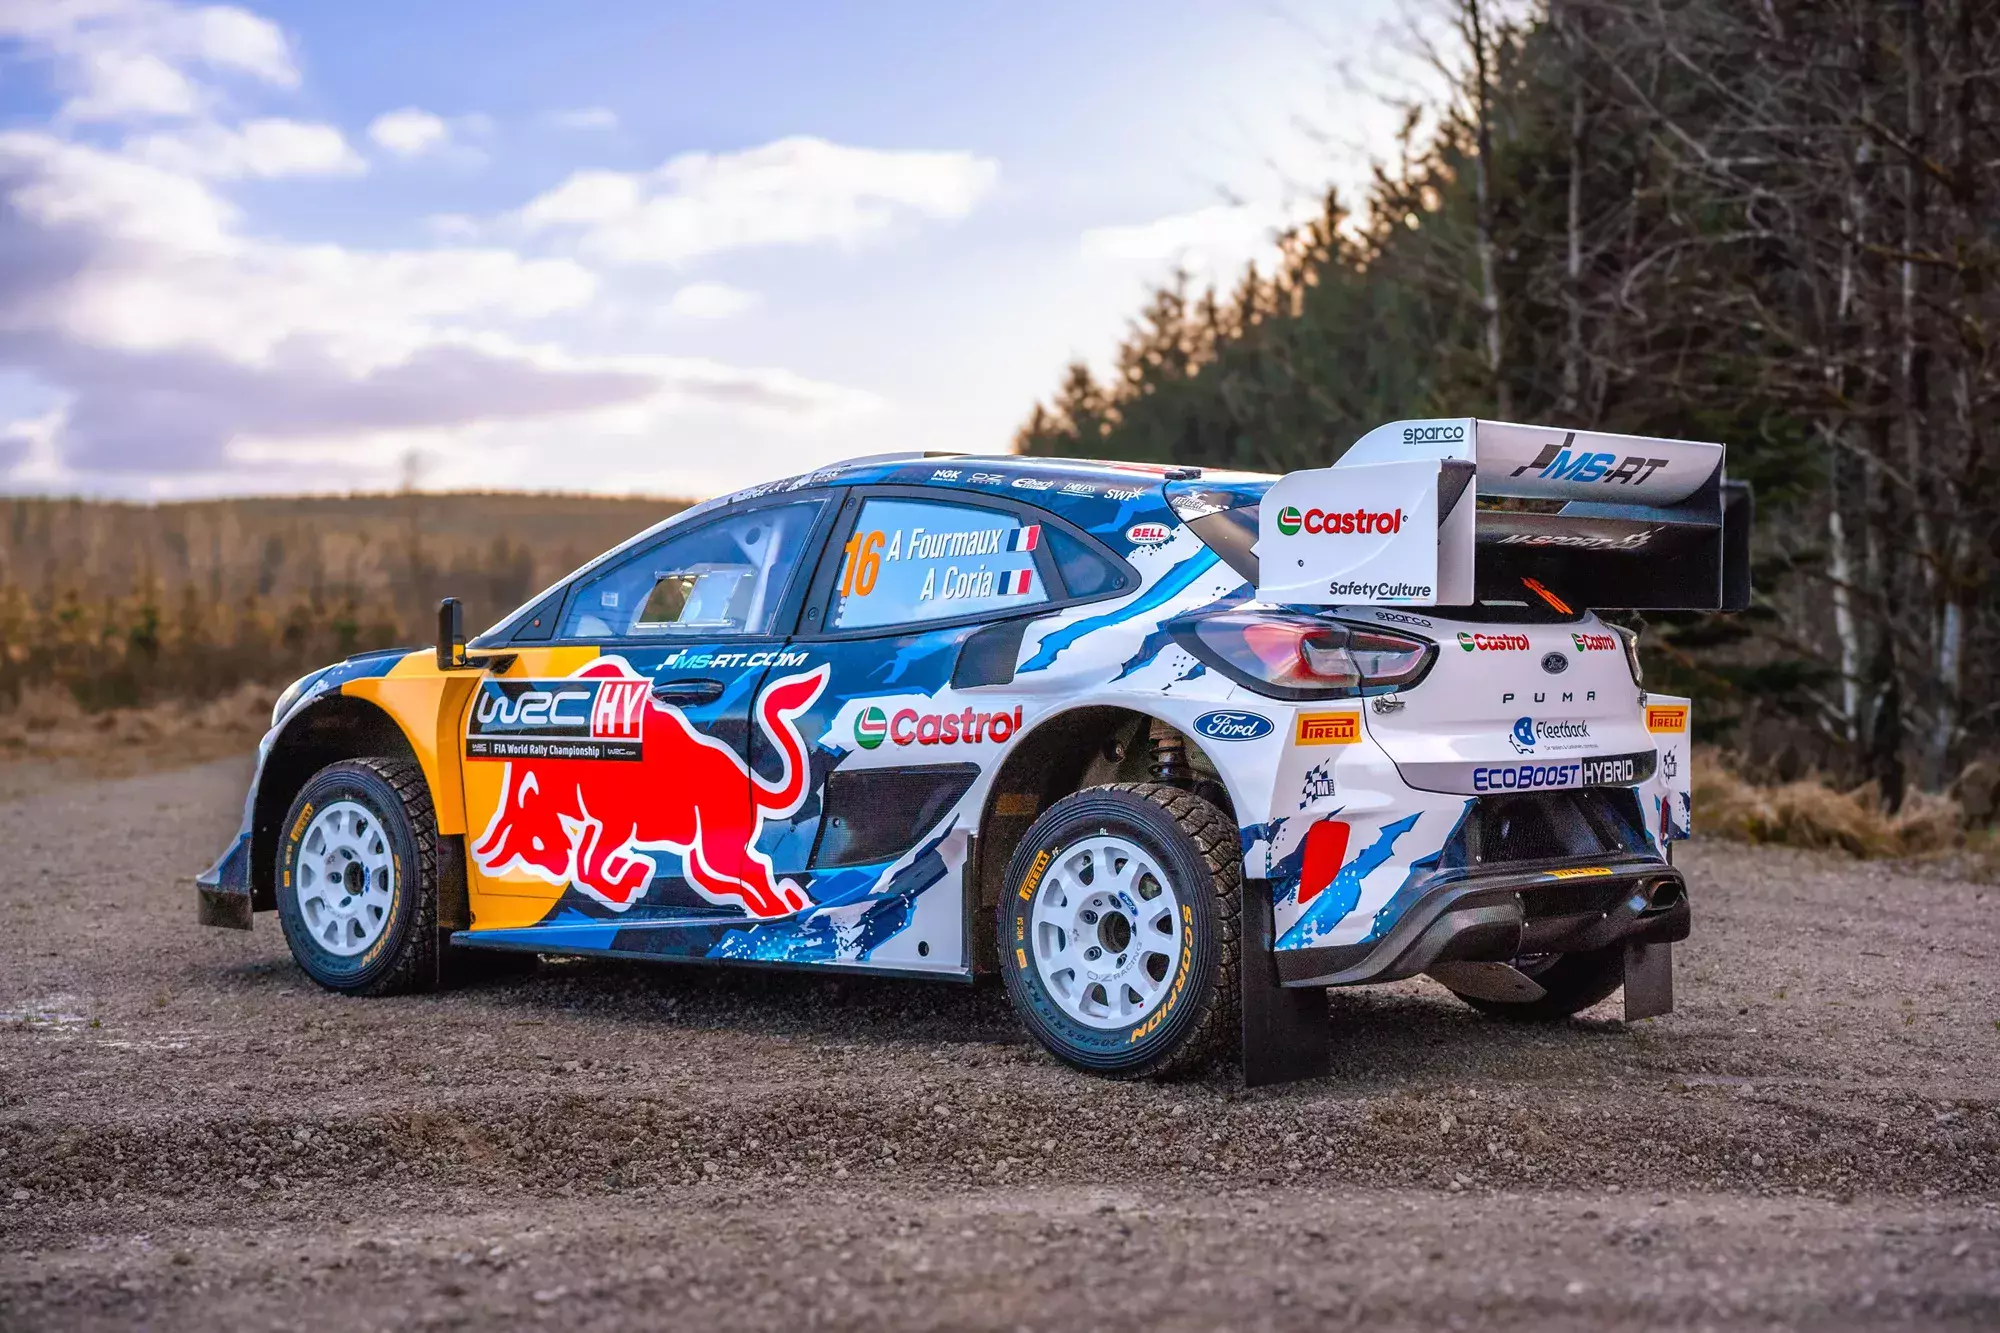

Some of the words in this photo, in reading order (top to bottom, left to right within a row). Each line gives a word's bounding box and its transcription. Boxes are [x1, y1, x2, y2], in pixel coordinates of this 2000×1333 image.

[1402, 426, 1464, 445] sparco
[933, 469, 962, 479] NGK
[1538, 449, 1669, 485] MS-RT
[1104, 488, 1136, 501] SWP
[1304, 508, 1401, 535] Castrol
[1132, 528, 1164, 538] BELL
[886, 529, 902, 562] A
[907, 527, 1003, 561] Fourmaux
[844, 530, 885, 597] 16
[920, 568, 936, 600] A
[943, 564, 994, 600] Coria
[1329, 581, 1432, 600] SafetyCulture
[1375, 611, 1433, 628] sparco
[1474, 633, 1530, 651] Castrol
[1582, 634, 1617, 651] Castrol
[1502, 691, 1596, 704] PUMA
[477, 691, 591, 725] WRC
[596, 684, 647, 735] HY
[1649, 710, 1684, 728] PIRELLI
[890, 704, 1023, 746] Castrol
[1207, 713, 1259, 737] Ford
[1301, 718, 1355, 740] PIRELLI
[1536, 720, 1591, 739] Fleetback
[494, 743, 507, 754] FIA
[508, 744, 529, 755] World
[530, 744, 548, 758] Rally
[549, 744, 600, 758] Championship
[1583, 759, 1634, 785] HYBRID
[1019, 850, 1050, 901] PIRELLI
[1113, 941, 1143, 980] RACING
[1130, 904, 1194, 1043] SCORPION
